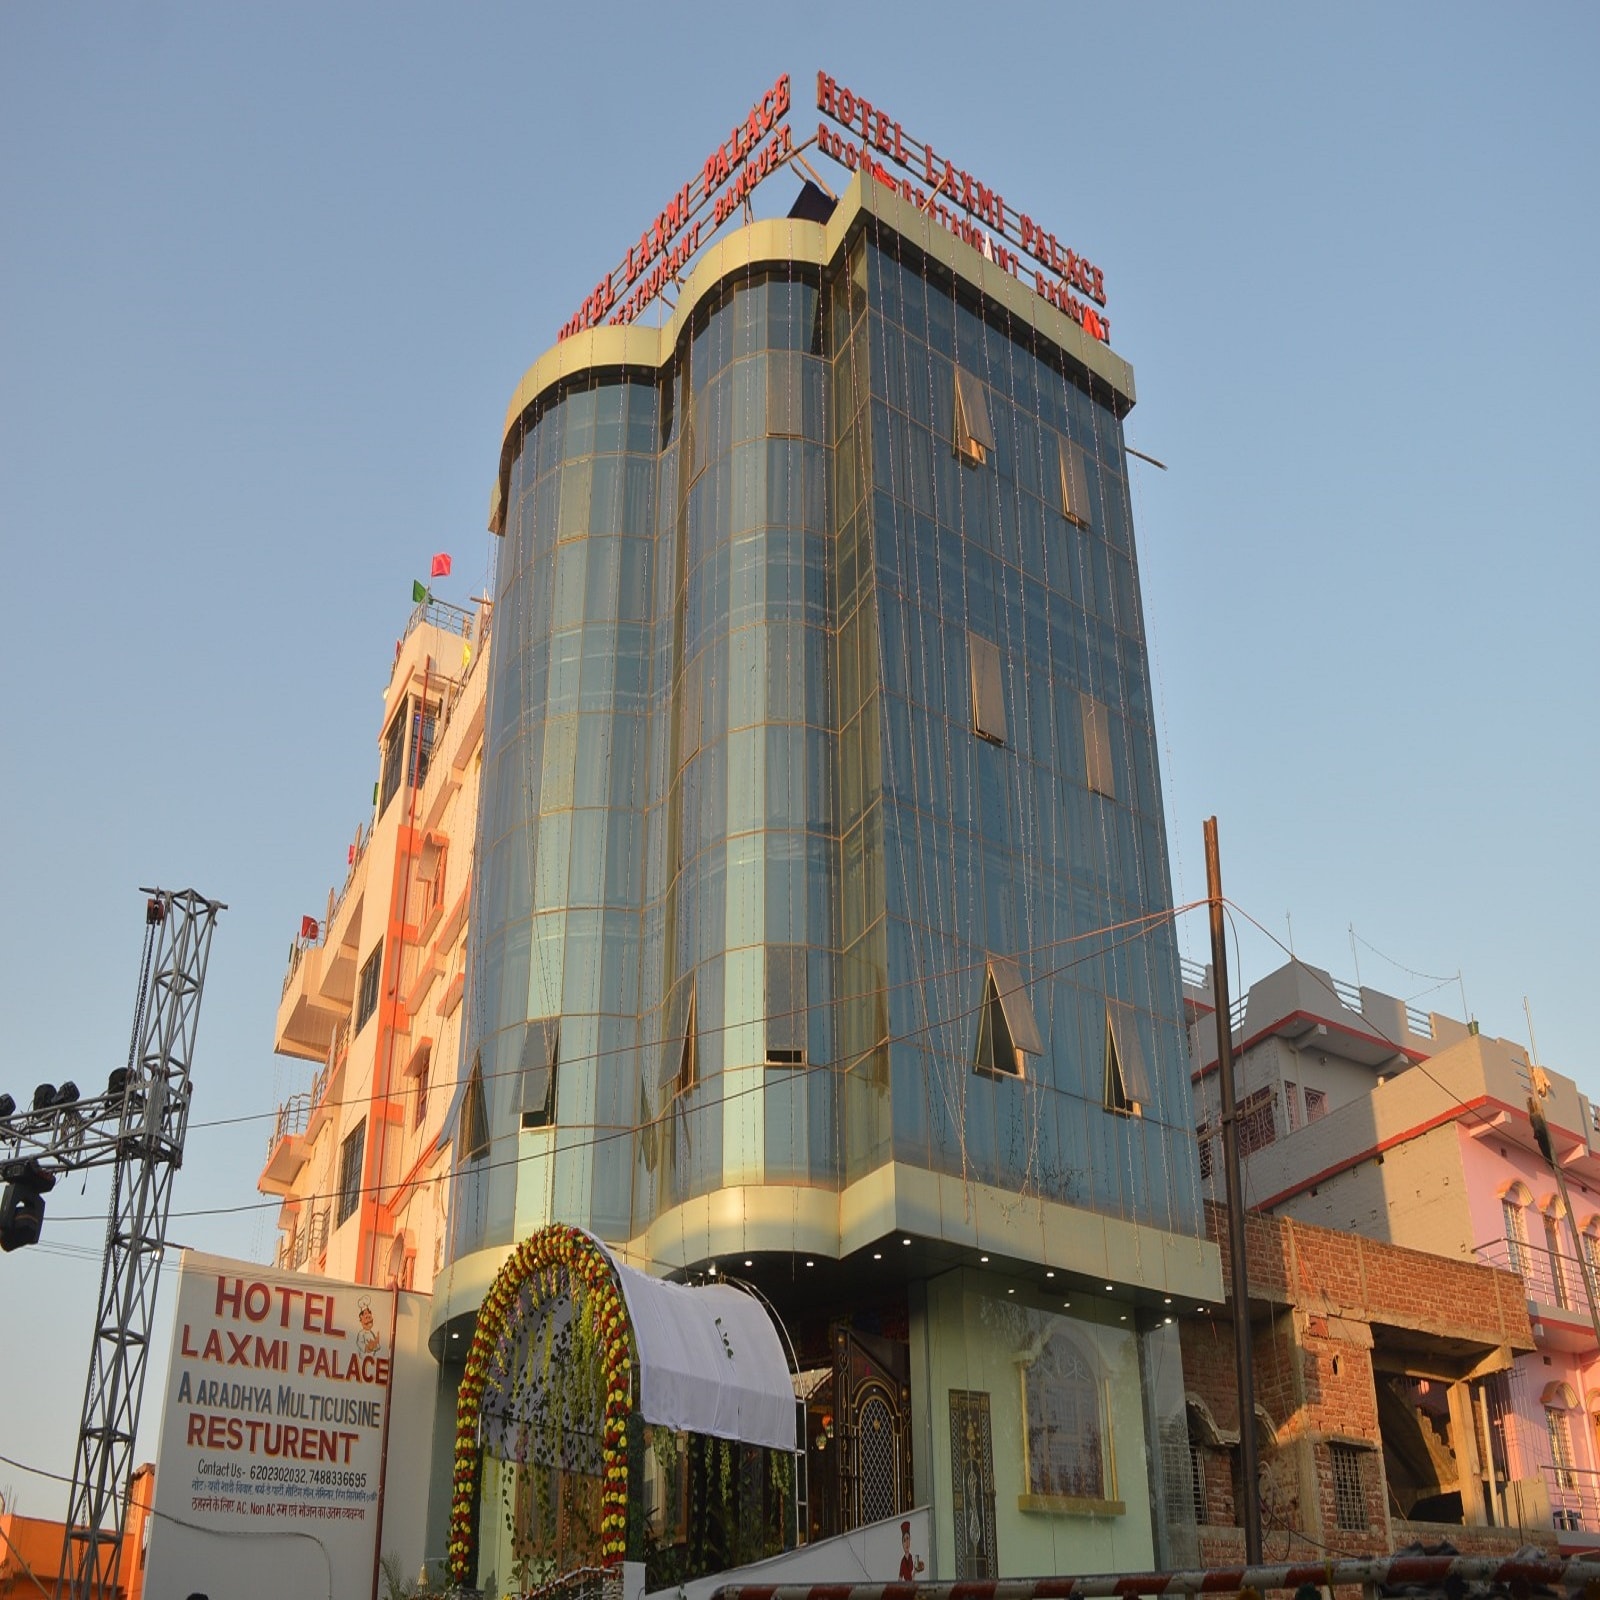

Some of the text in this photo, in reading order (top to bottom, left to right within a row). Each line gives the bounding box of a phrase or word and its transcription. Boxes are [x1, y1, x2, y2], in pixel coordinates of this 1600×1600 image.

[625, 183, 690, 286] LAXMI
[703, 72, 790, 198] PALACE
[714, 123, 791, 225] BANQUET
[817, 70, 1107, 307] HOTEL LAXMI PALACE
[817, 122, 883, 179] ROOM
[1035, 270, 1111, 346] BANQT
[215, 1276, 346, 1338] HOTEL
[181, 1324, 390, 1386] LAXMI PALACE
[276, 1384, 381, 1428] MULTICUISINE
[187, 1413, 359, 1464] RESTURENT
[198, 1458, 230, 1477] Contact
[250, 1502, 265, 1516] Non
